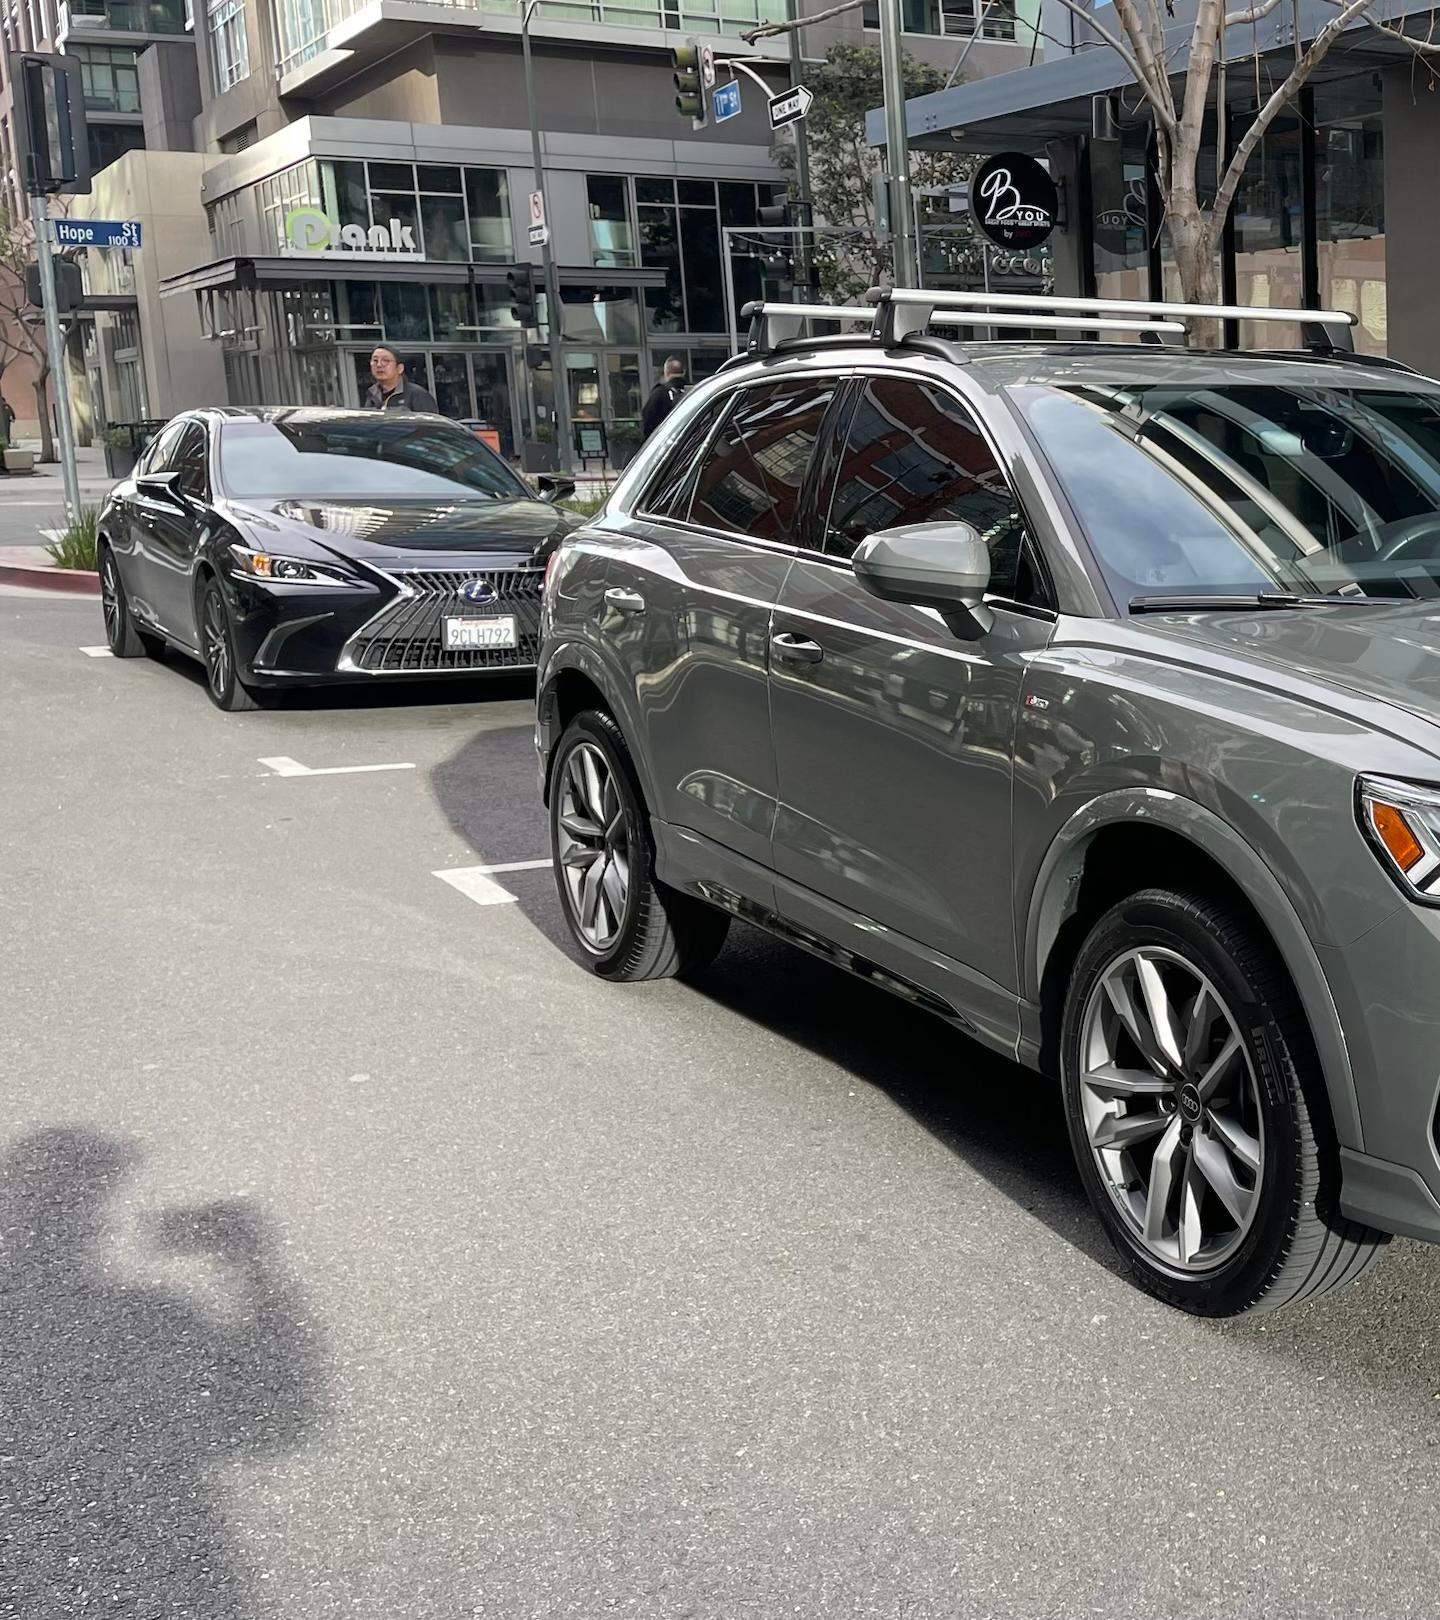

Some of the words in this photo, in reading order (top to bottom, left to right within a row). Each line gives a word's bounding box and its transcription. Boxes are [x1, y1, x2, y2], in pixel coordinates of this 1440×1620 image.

[1016, 210, 1044, 222] YOU
[59, 224, 94, 243] Hope
[122, 223, 138, 238] St
[1003, 229, 1014, 239] by
[108, 235, 128, 246] 1100
[132, 236, 139, 246] S
[451, 628, 511, 645] 9CLH792
